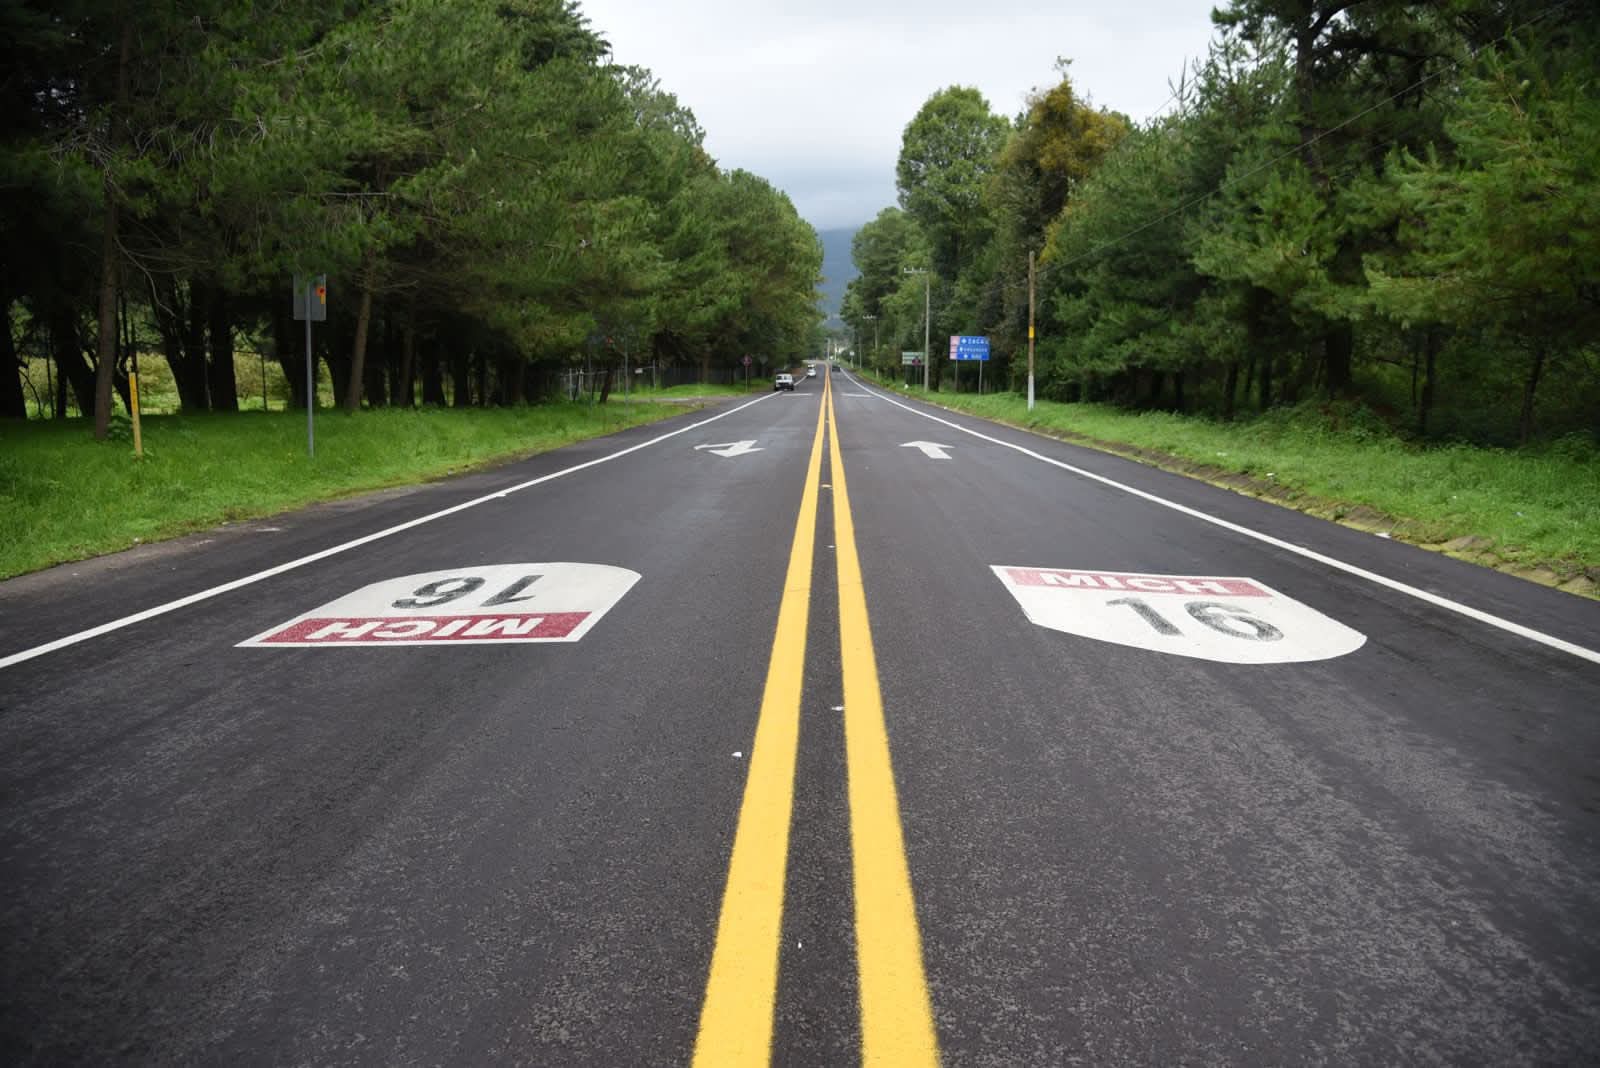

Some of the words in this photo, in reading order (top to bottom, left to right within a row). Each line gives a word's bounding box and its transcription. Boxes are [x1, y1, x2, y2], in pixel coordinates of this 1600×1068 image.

[390, 574, 545, 610] 16
[1038, 572, 1231, 594] MICH
[312, 617, 544, 639] MICH
[1105, 597, 1284, 642] 16
